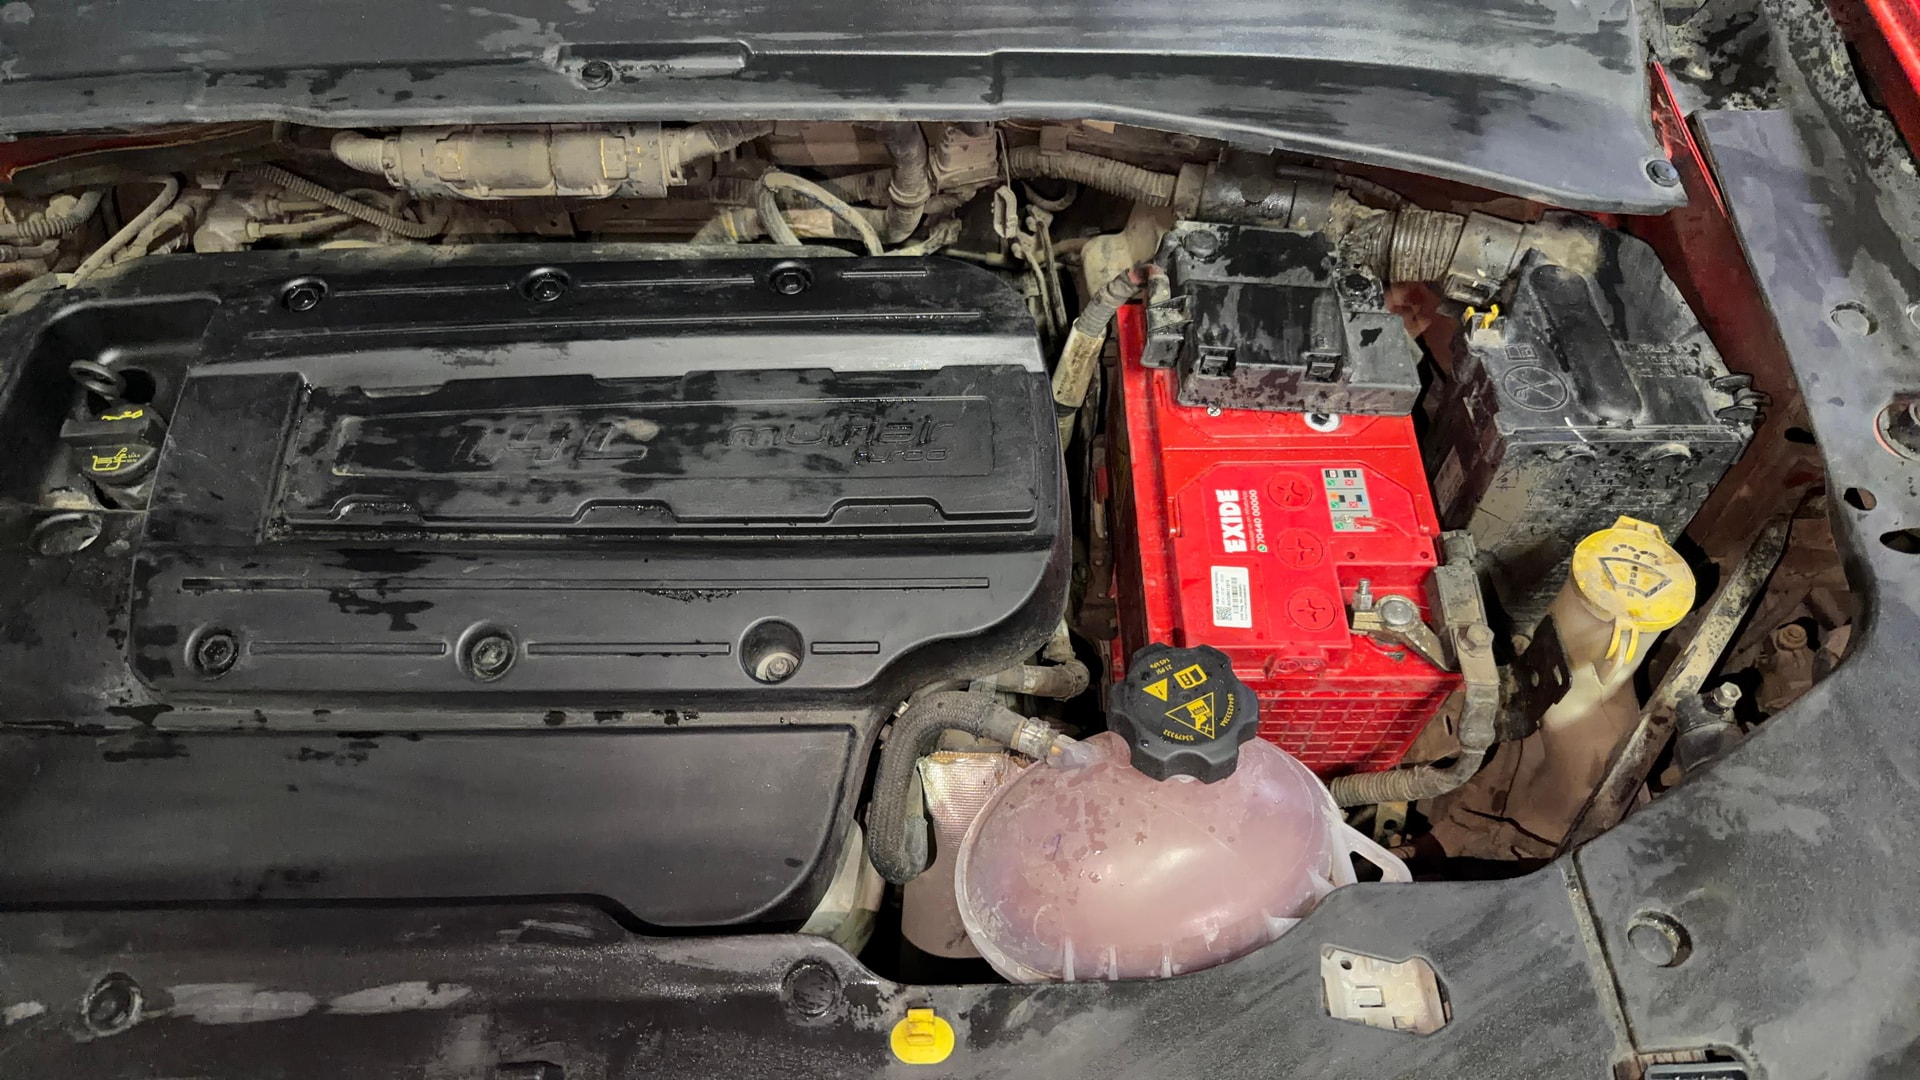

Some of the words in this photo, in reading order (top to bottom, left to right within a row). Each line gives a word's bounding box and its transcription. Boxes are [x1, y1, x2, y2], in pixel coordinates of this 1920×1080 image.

[1249, 490, 1260, 516] 00000
[1215, 489, 1248, 553] EXIDE
[1254, 518, 1265, 543] 70440
